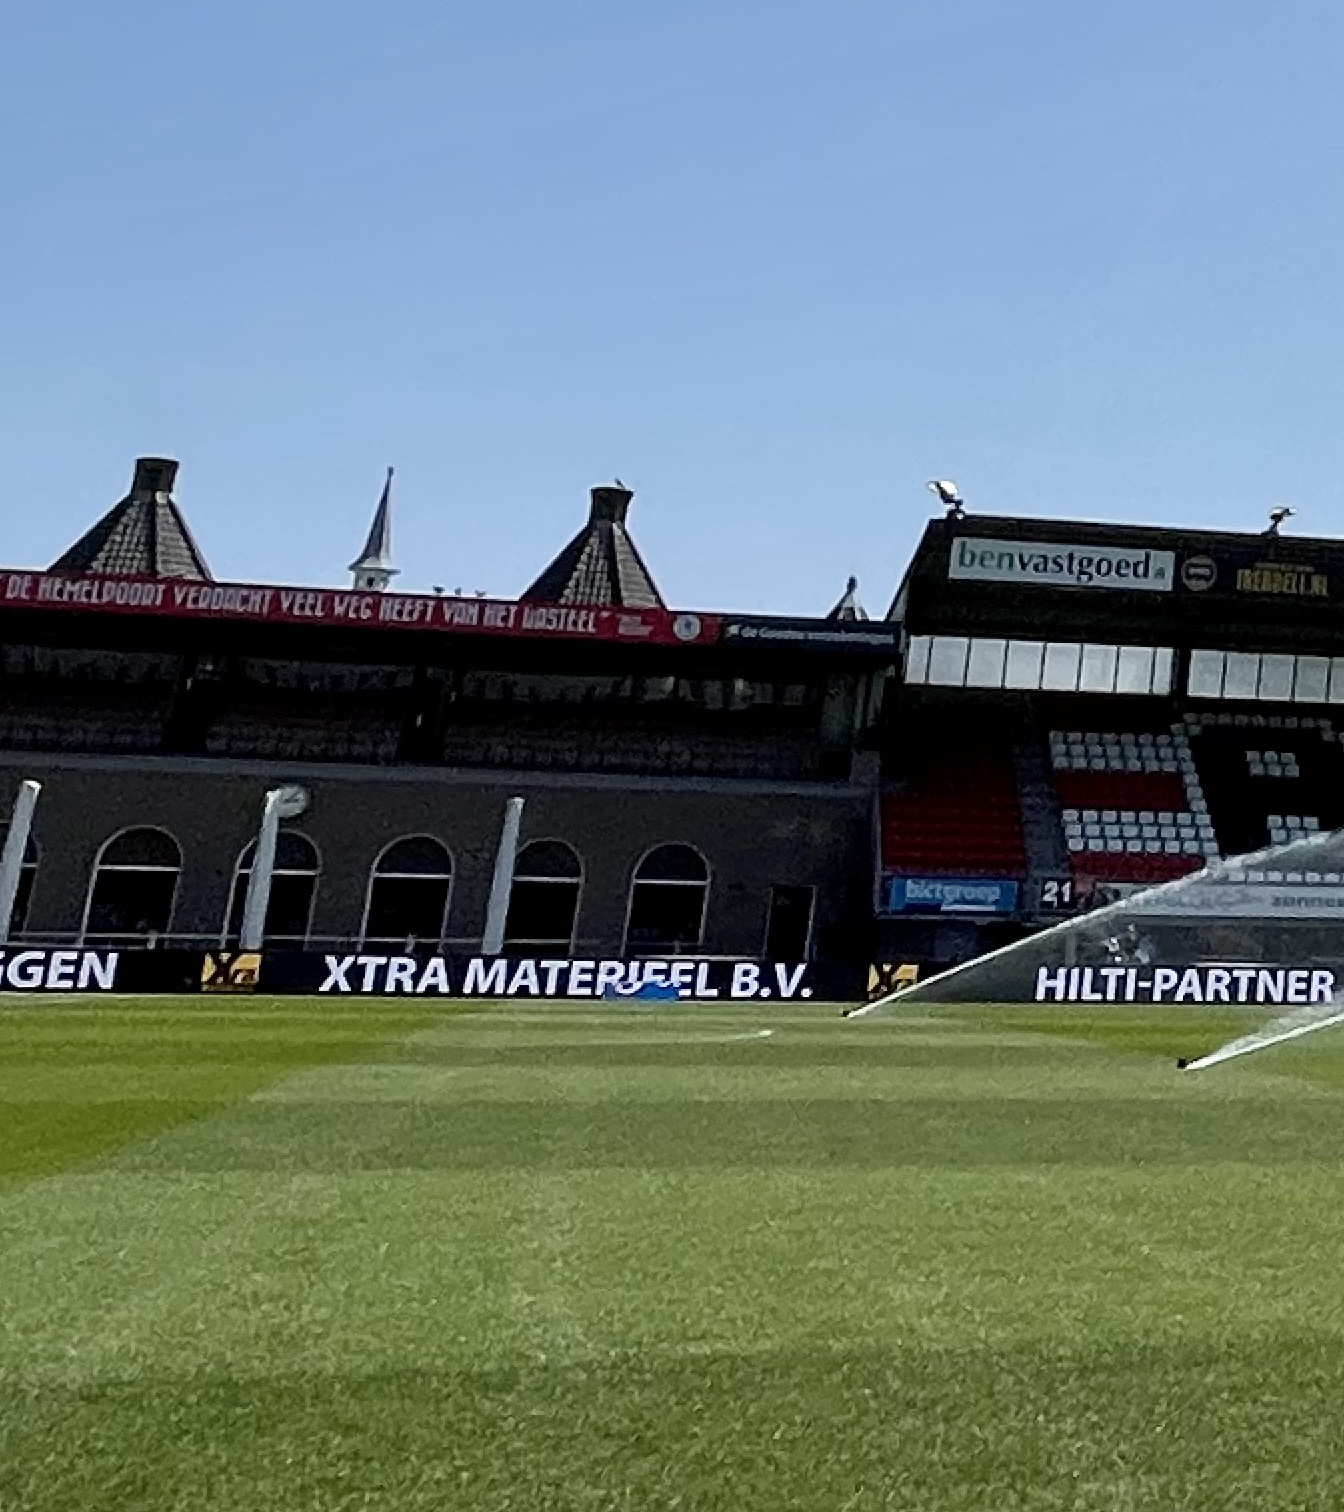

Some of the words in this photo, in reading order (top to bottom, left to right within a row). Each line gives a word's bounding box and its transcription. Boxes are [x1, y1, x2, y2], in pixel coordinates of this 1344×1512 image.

[958, 538, 1151, 582] benvastgoed
[280, 589, 326, 618] VEEL
[334, 593, 372, 621] WEG
[1042, 879, 1071, 908] 21
[0, 951, 119, 989] GEN
[319, 954, 450, 992] XTRA
[731, 963, 813, 998] B.V.
[1036, 967, 1335, 1003] HILTI-PARTNER
